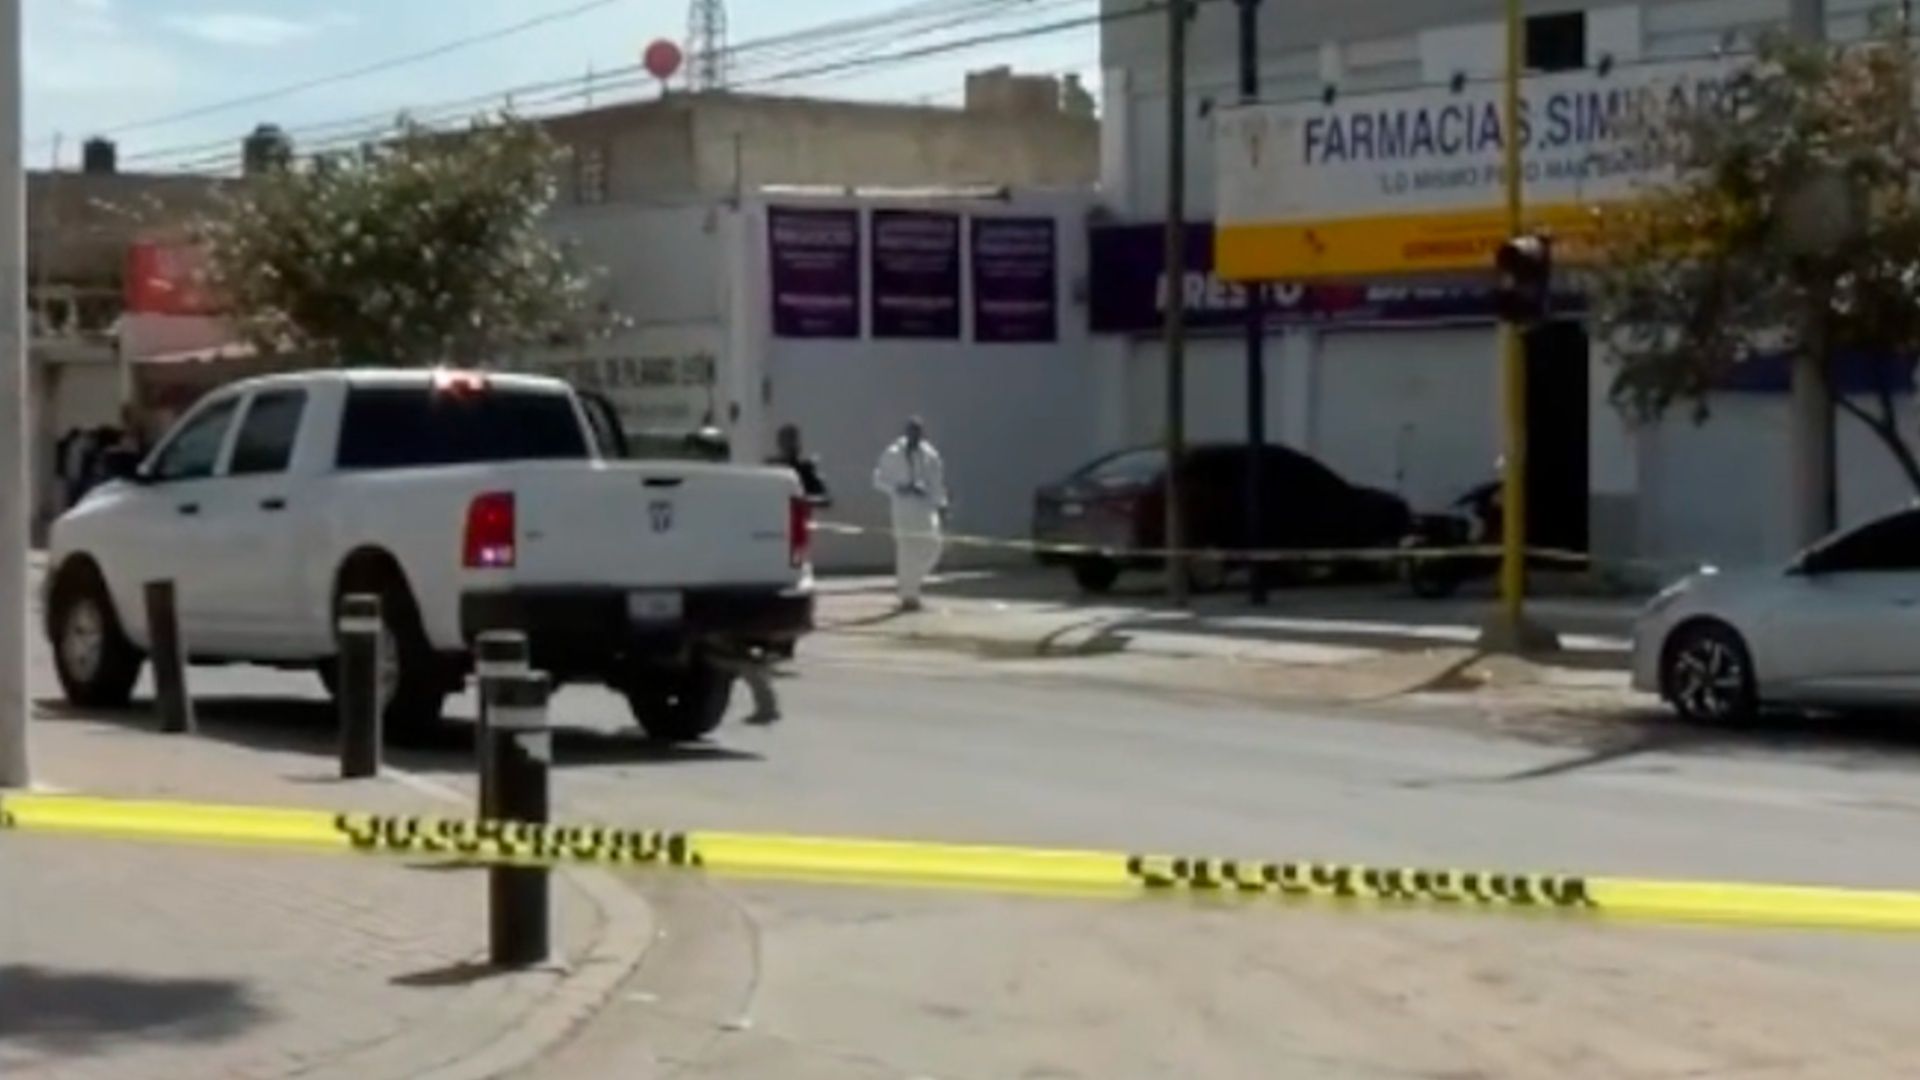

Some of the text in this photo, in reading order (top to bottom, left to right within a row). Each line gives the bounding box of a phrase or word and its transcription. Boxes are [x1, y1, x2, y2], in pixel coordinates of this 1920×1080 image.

[1303, 98, 1531, 165] FARMACIAS
[1413, 167, 1477, 190] MISMO
[1485, 162, 1540, 184] PEO
